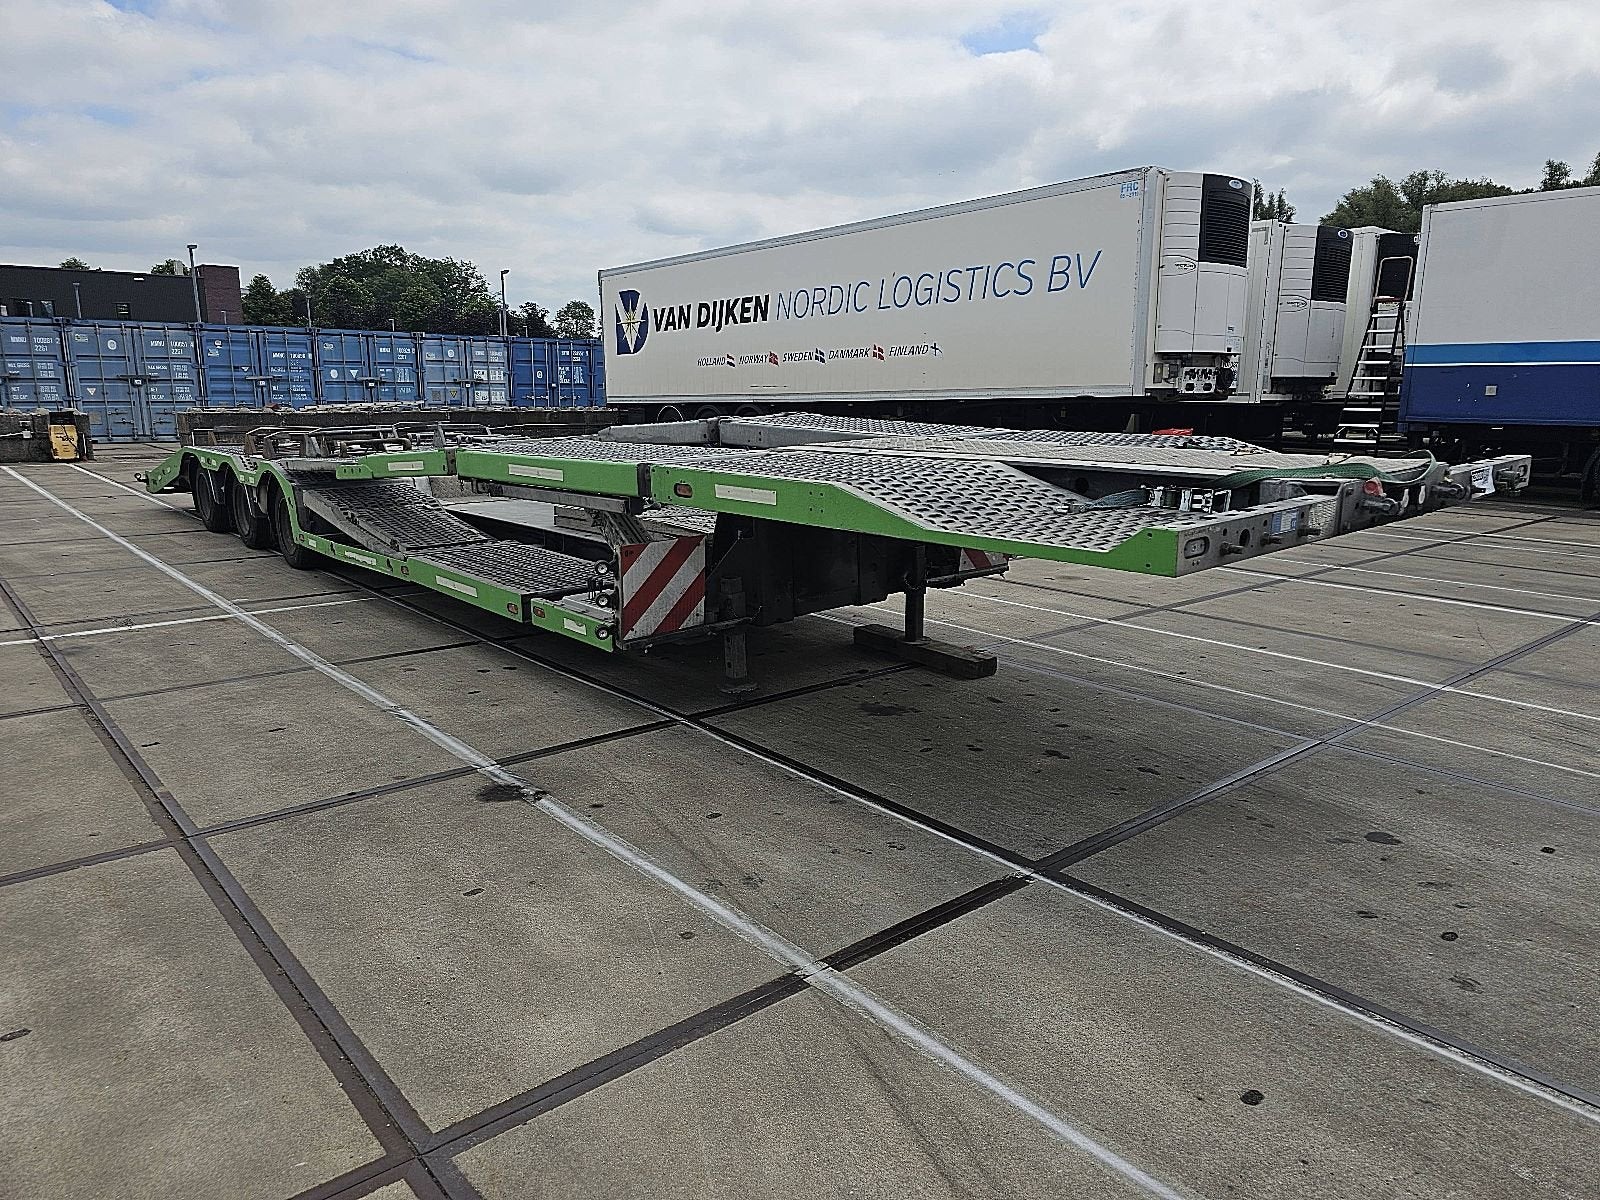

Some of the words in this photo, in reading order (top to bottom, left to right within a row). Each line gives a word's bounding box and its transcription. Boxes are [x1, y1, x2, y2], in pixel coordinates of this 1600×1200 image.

[653, 304, 692, 332] VAN
[697, 294, 769, 332] DIJKEN
[776, 281, 870, 320] NORDIC
[878, 259, 1036, 310] LOGISTICS
[1047, 250, 1102, 293] BV
[697, 357, 726, 367] HOLLAND
[739, 354, 769, 365] NORWAY
[782, 351, 814, 362] SWEDEN
[828, 347, 871, 359] DANMARK
[888, 344, 929, 357] FINLAND
